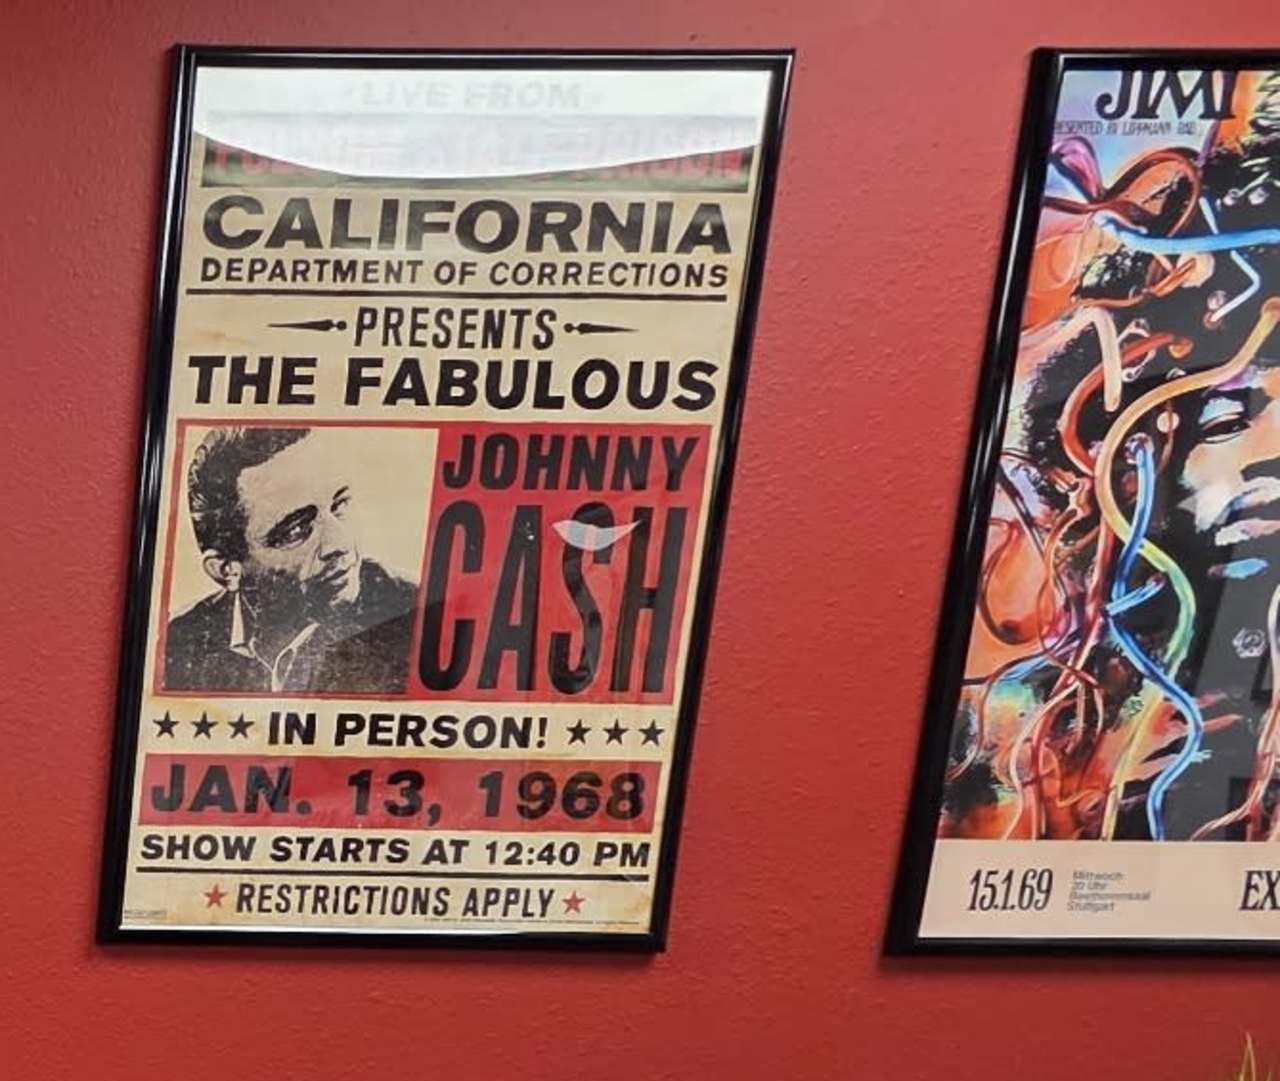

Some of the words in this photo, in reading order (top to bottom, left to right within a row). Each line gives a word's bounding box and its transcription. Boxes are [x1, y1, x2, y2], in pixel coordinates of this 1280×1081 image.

[360, 80, 452, 111] LIVE
[464, 81, 581, 113] FROM
[1095, 70, 1239, 120] JIMI
[201, 193, 732, 255] CALIFORNIA
[200, 257, 422, 286] DEPARTMENT
[434, 260, 479, 286] OF
[489, 261, 729, 288] CORRECTIONS
[353, 306, 558, 351] PRESENTS
[188, 355, 317, 405] THE
[344, 356, 719, 411] FABULOUS
[441, 432, 698, 492] JOHNNY
[417, 498, 688, 695] CASH
[267, 711, 316, 745] IN
[334, 713, 548, 749] PERSON!
[150, 763, 311, 814] JAN.
[347, 769, 442, 826] 13,
[478, 770, 647, 820] 1968
[140, 833, 255, 862] SHOW
[269, 836, 410, 865] STARTS
[421, 838, 471, 866] AT
[484, 840, 580, 867] 12:40
[592, 841, 651, 868] PM
[235, 880, 450, 919] RESTRICTIONS
[462, 886, 556, 919] APPLY
[967, 867, 1053, 911] 15.1.69
